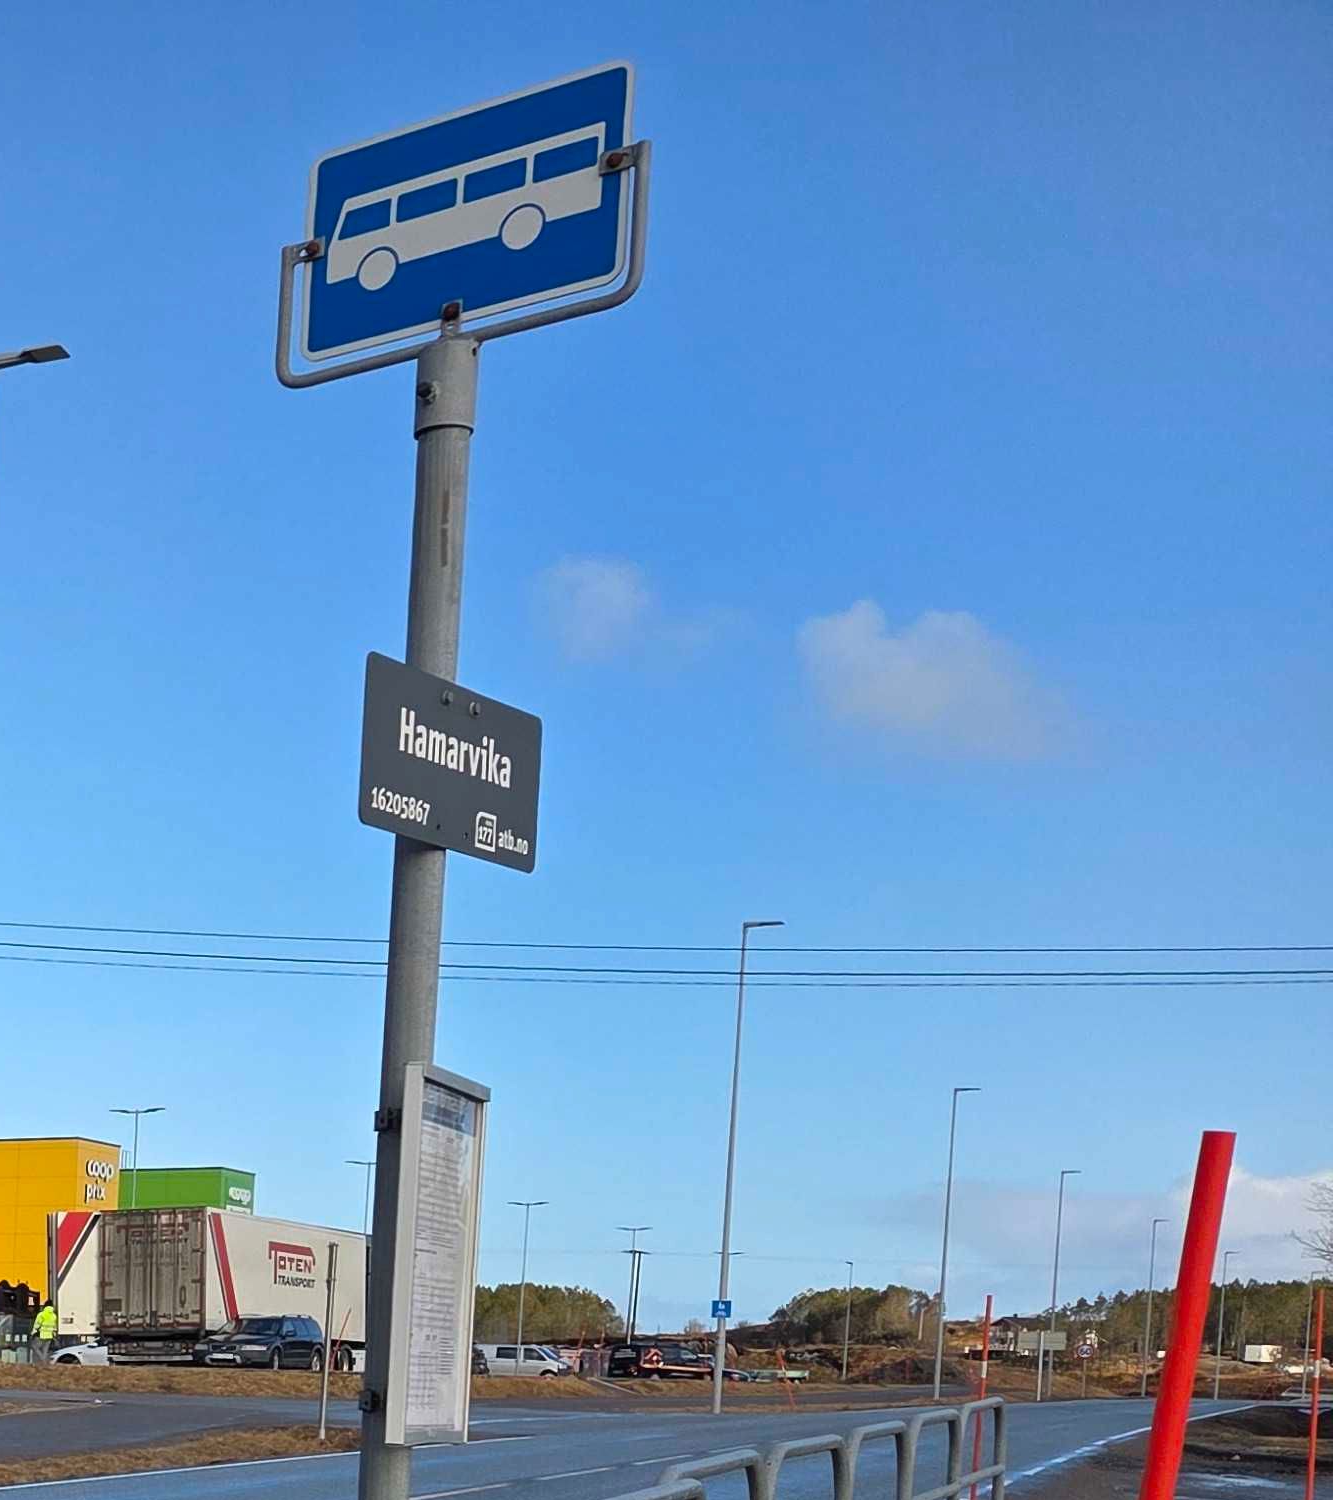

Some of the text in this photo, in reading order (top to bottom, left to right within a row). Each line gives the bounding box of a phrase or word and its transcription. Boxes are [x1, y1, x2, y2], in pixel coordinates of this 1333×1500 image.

[399, 706, 512, 789] Hamarvika
[371, 785, 431, 826] 16205867
[498, 828, 529, 855] atb.no
[86, 1159, 114, 1183] coop
[268, 1240, 316, 1285] TOTEN
[277, 1275, 316, 1289] TRANSPORT
